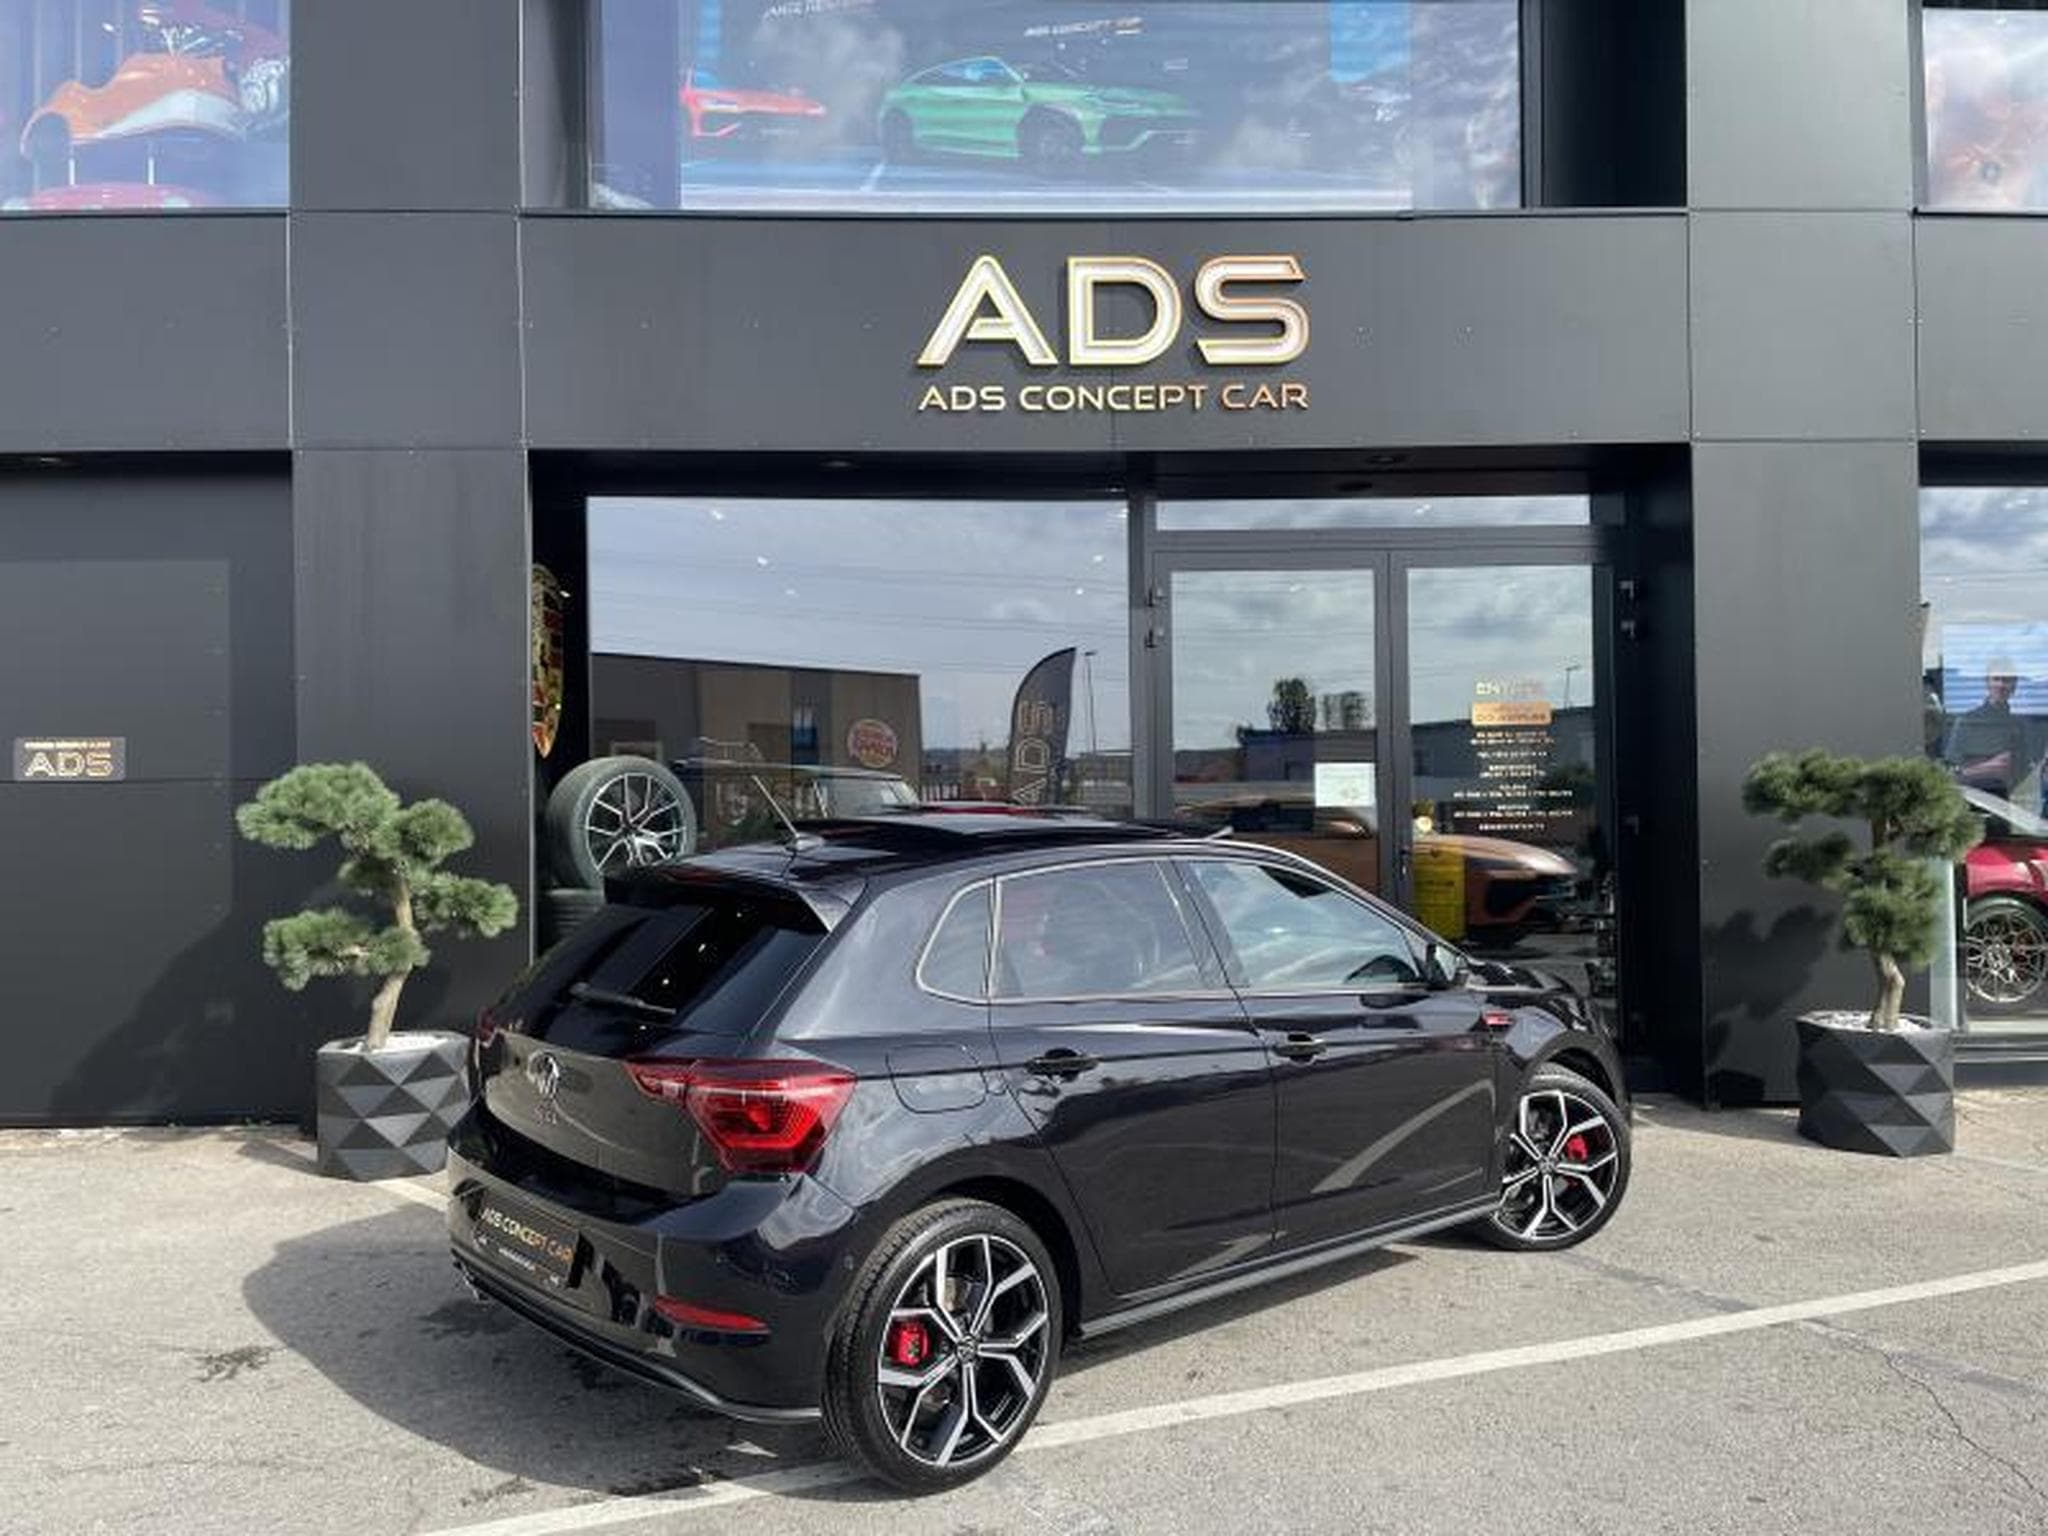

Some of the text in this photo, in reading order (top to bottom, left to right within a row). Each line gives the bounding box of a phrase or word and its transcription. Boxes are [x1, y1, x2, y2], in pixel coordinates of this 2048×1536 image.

[917, 255, 1309, 365] ADS
[918, 384, 1310, 411] ADS CONCEPT CAR
[25, 752, 113, 777] ADS
